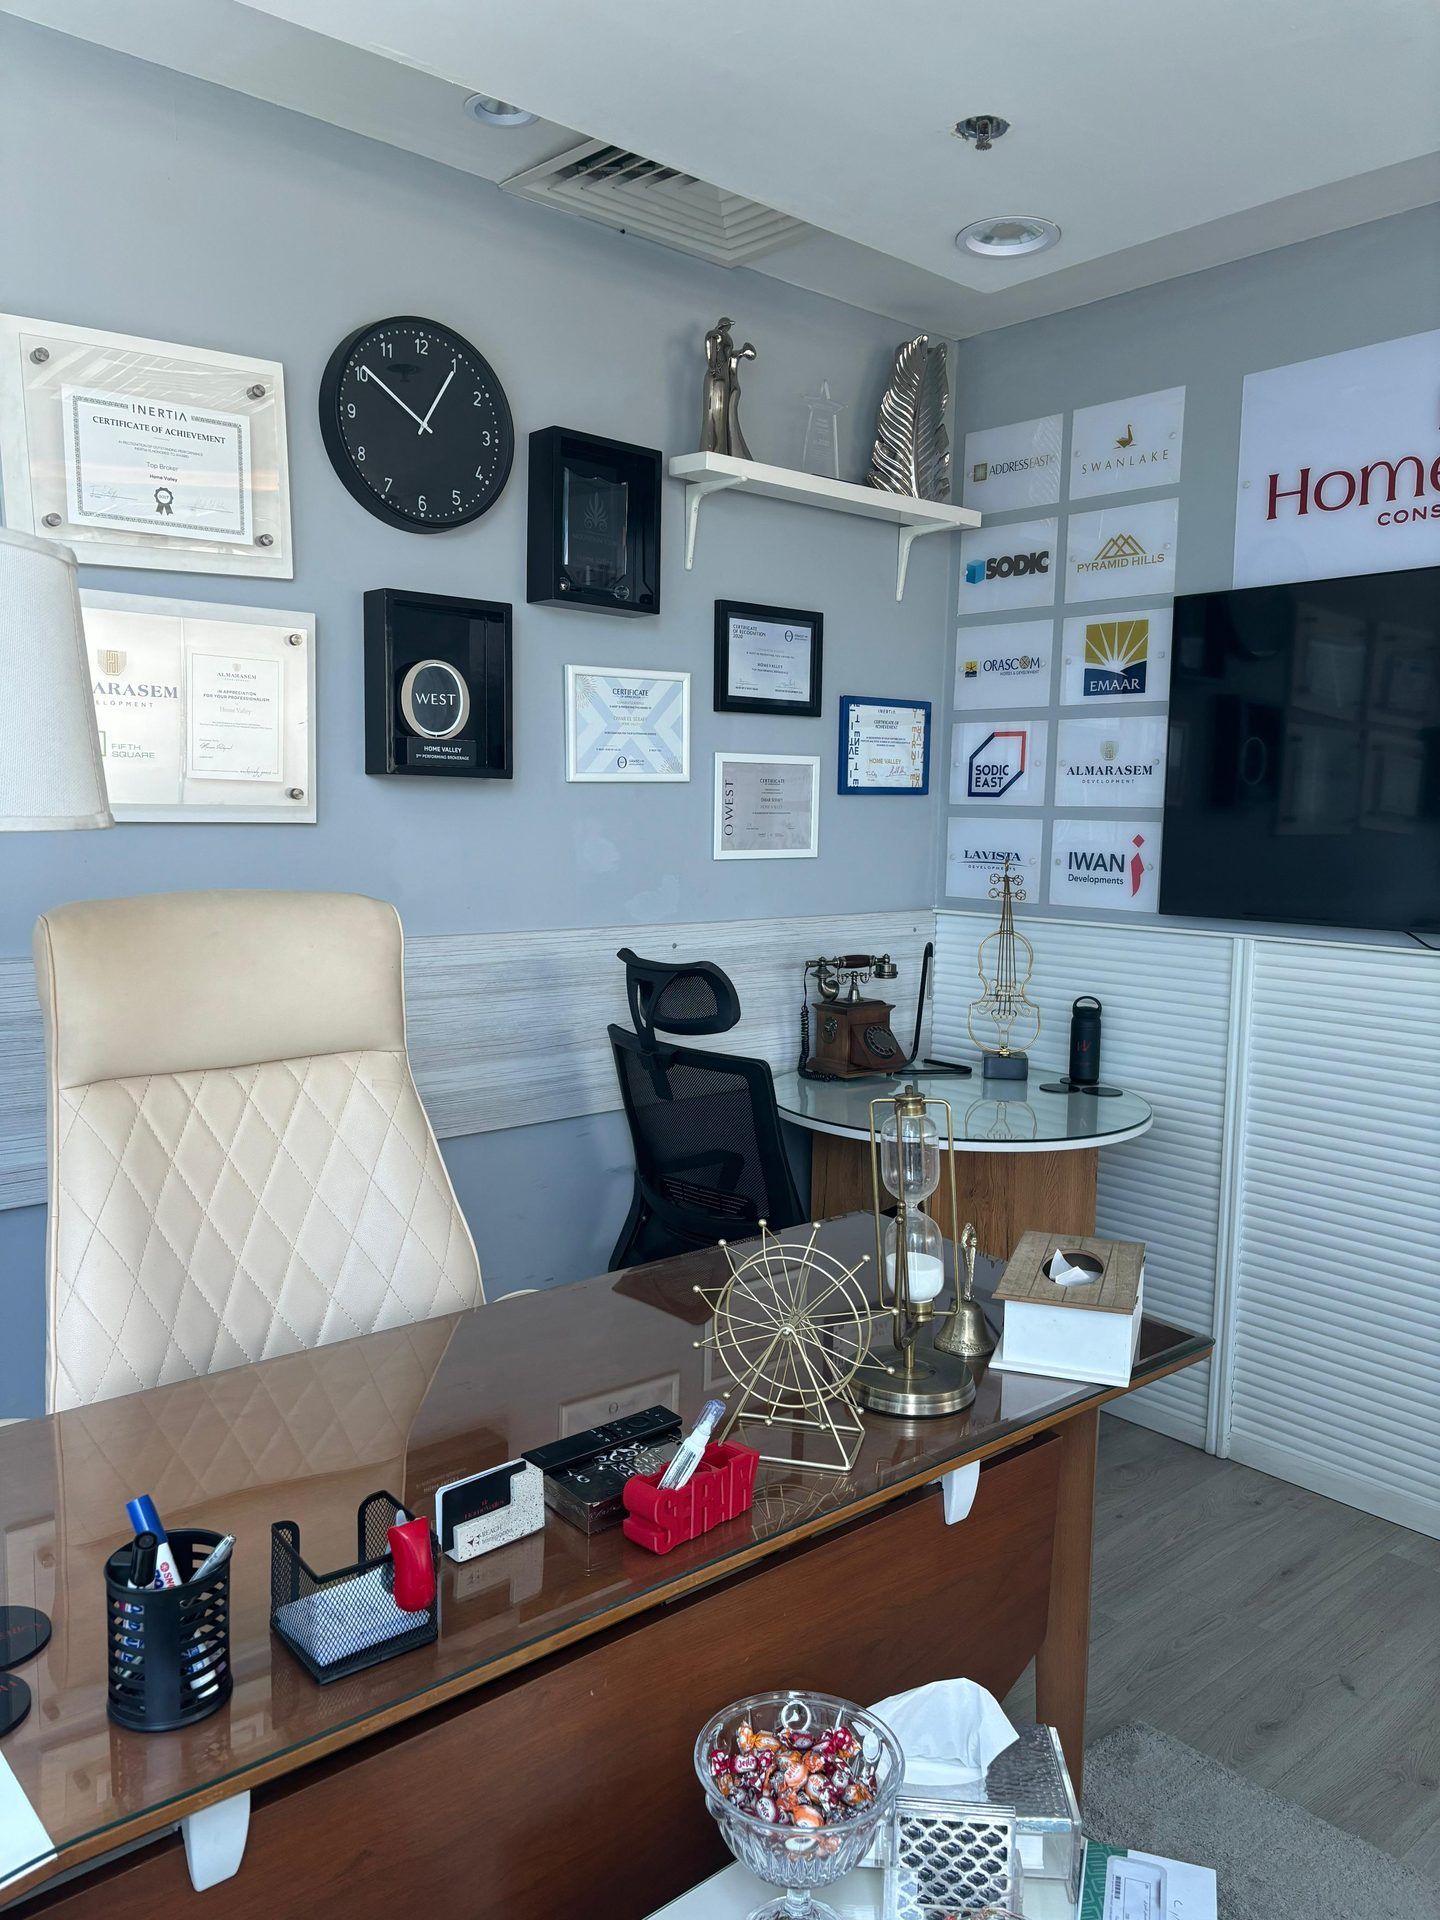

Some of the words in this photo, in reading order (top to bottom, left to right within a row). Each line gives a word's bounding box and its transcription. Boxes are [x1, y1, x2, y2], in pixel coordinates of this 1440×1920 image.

[380, 342, 392, 358] 11
[414, 338, 428, 355] 12
[451, 358, 457, 373] 1
[354, 365, 368, 382] 10
[473, 391, 482, 406] 2
[132, 403, 188, 422] INERTIA
[347, 403, 356, 418] 9
[92, 415, 150, 432] CERTIFICATE
[151, 425, 163, 434] OF
[164, 428, 226, 445] ACHIEVEMENT
[482, 430, 491, 446] 3
[357, 446, 366, 461] 8
[147, 461, 158, 470] Top
[475, 465, 483, 480] 4
[384, 477, 393, 492] 7
[1266, 455, 1440, 521] Hom
[418, 495, 427, 511] 6
[451, 489, 461, 505] 5
[985, 551, 1049, 580] SODIC
[1077, 558, 1129, 573] PYRAMID
[1131, 553, 1165, 567] HILLS
[983, 655, 1040, 672] ORASCOM
[612, 688, 649, 697] CERTIFICATE
[1090, 678, 1141, 693] EMAAR
[415, 692, 456, 706] WEST
[111, 743, 142, 751] FIFTH
[423, 745, 441, 753] HOME
[441, 746, 462, 754] VALLEY
[111, 751, 156, 759] SQUARE
[975, 764, 1010, 776] SODIC
[1066, 765, 1153, 776] ALMARASEM
[975, 776, 1004, 788] EAST
[724, 779, 734, 821] WEST
[1068, 851, 1125, 872] IWAN
[1067, 873, 1124, 885] Developments
